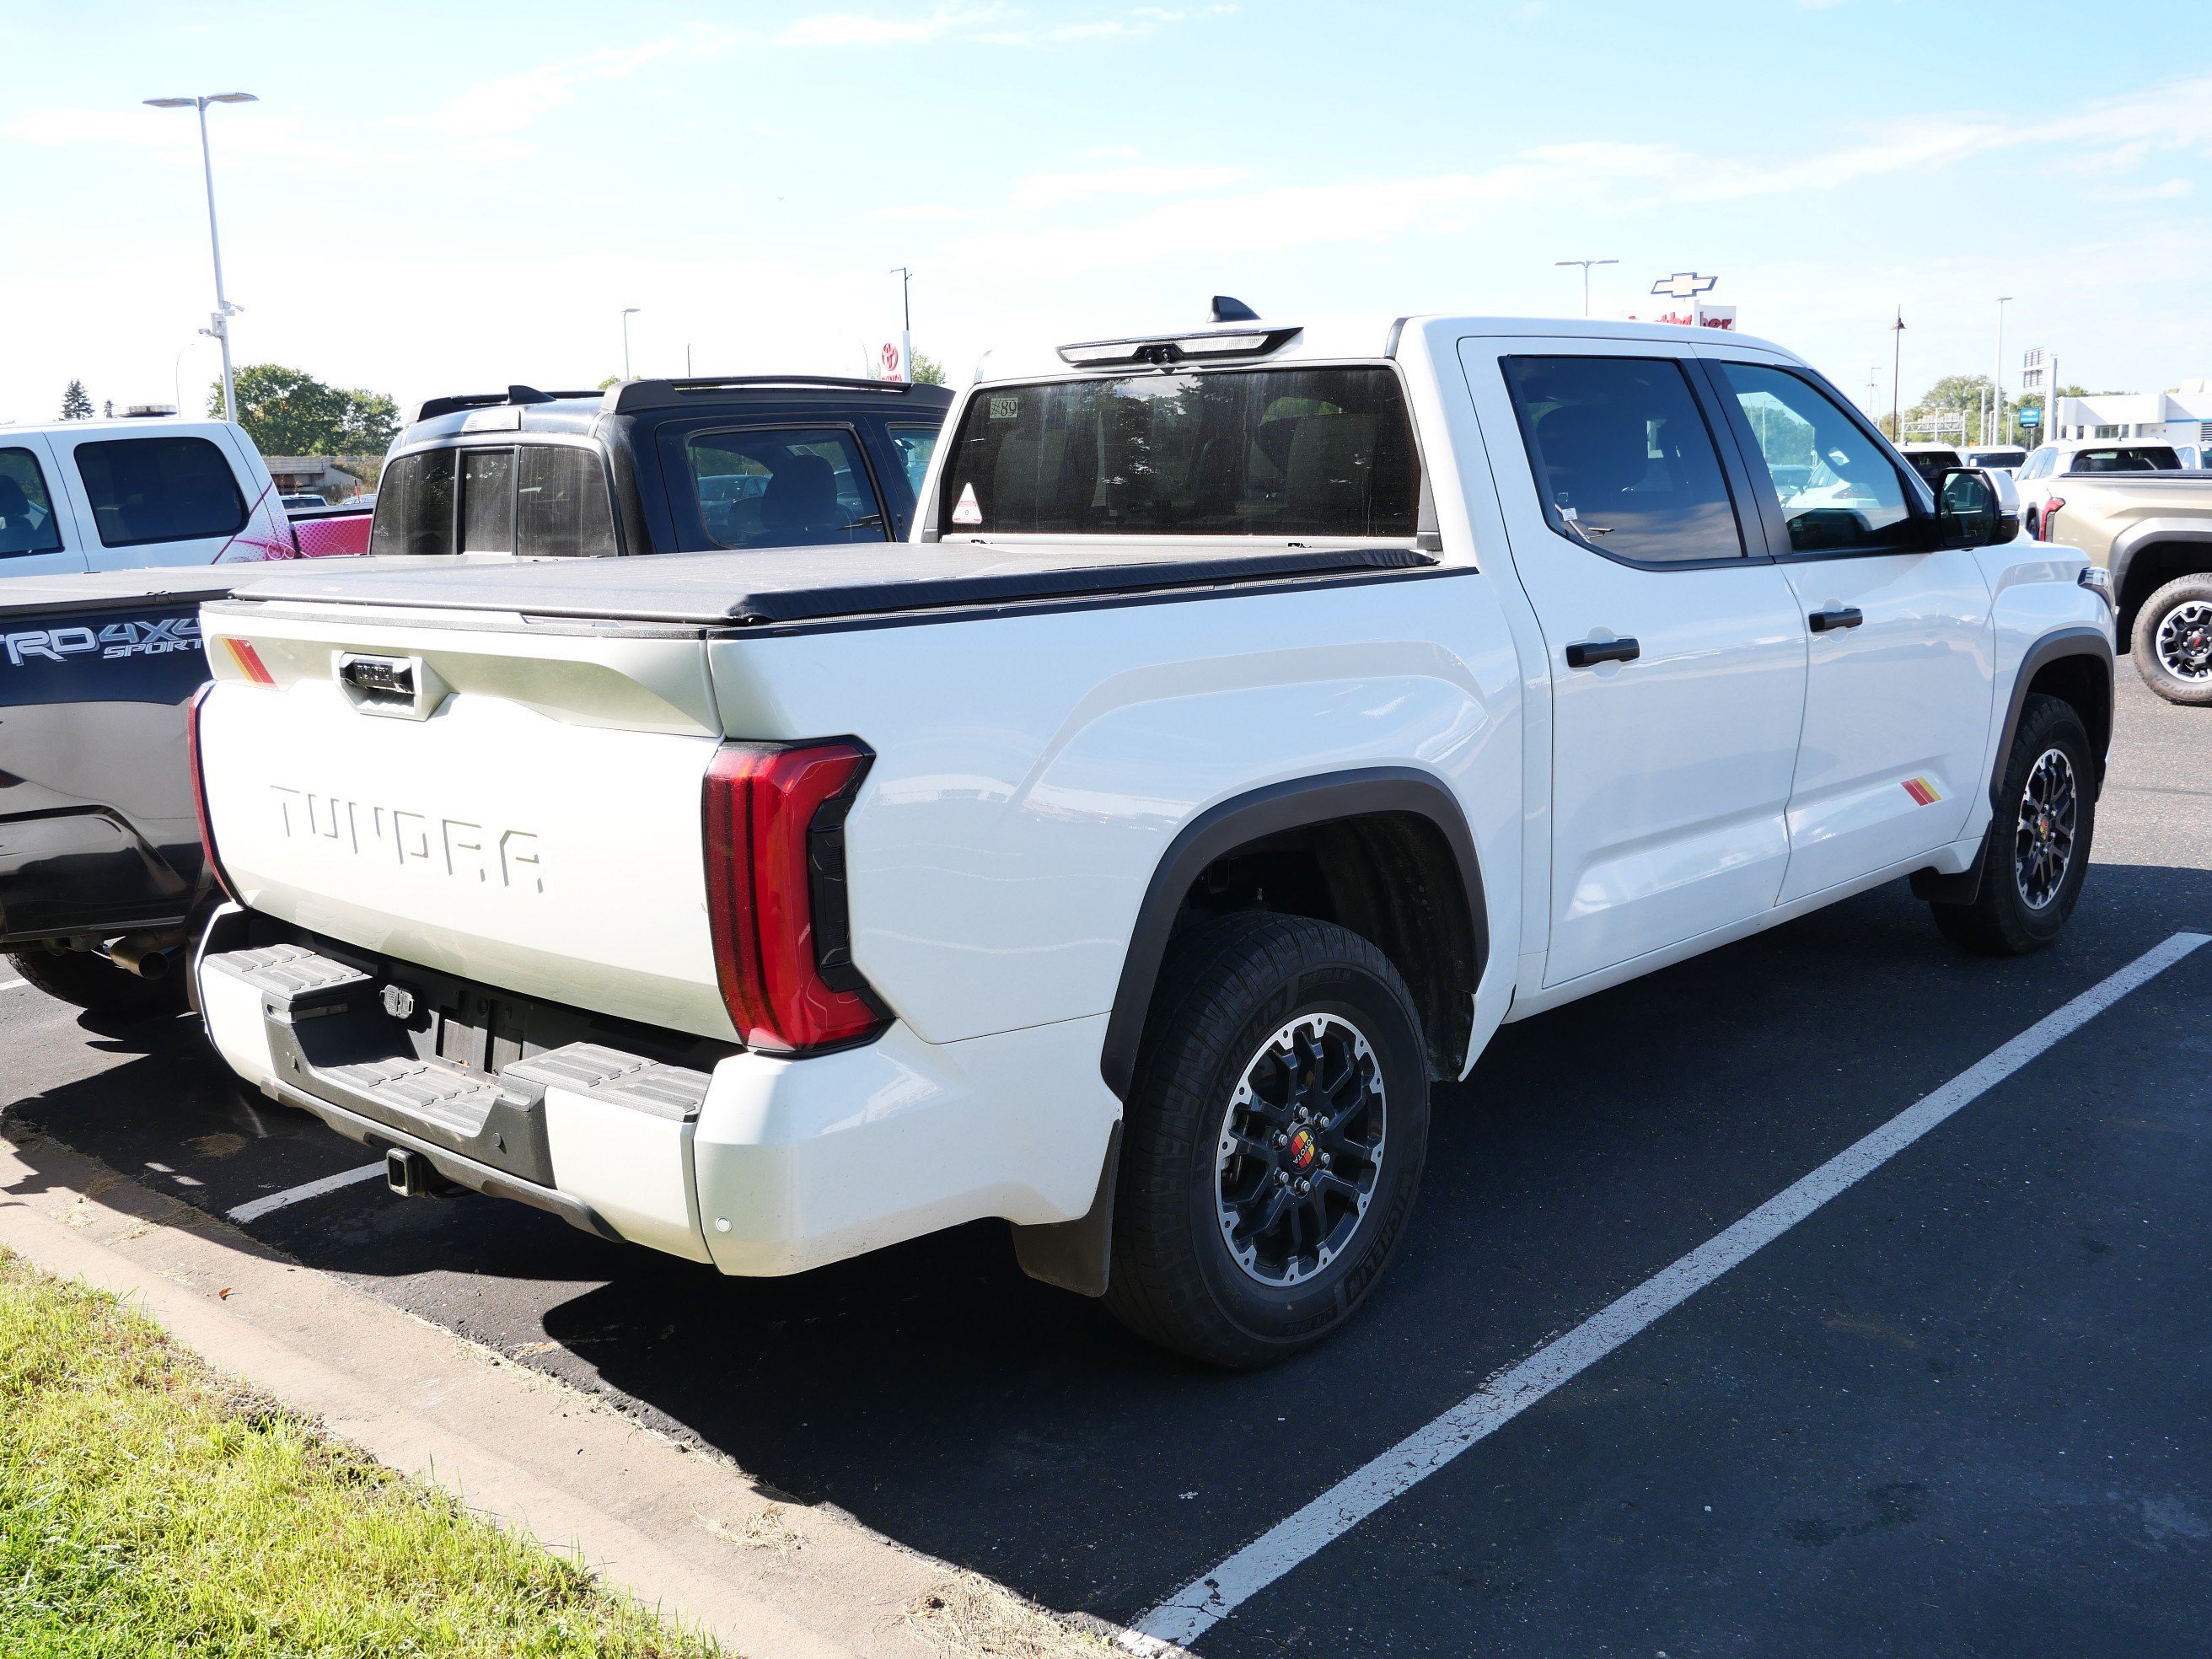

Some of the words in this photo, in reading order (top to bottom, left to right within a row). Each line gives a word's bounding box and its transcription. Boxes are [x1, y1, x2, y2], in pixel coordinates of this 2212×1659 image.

[0, 626, 100, 666] RD
[103, 638, 203, 659] SPORT
[357, 664, 393, 682] TOYOTA
[270, 785, 544, 894] TUNDRA
[1292, 1135, 1314, 1163] TOYOTA
